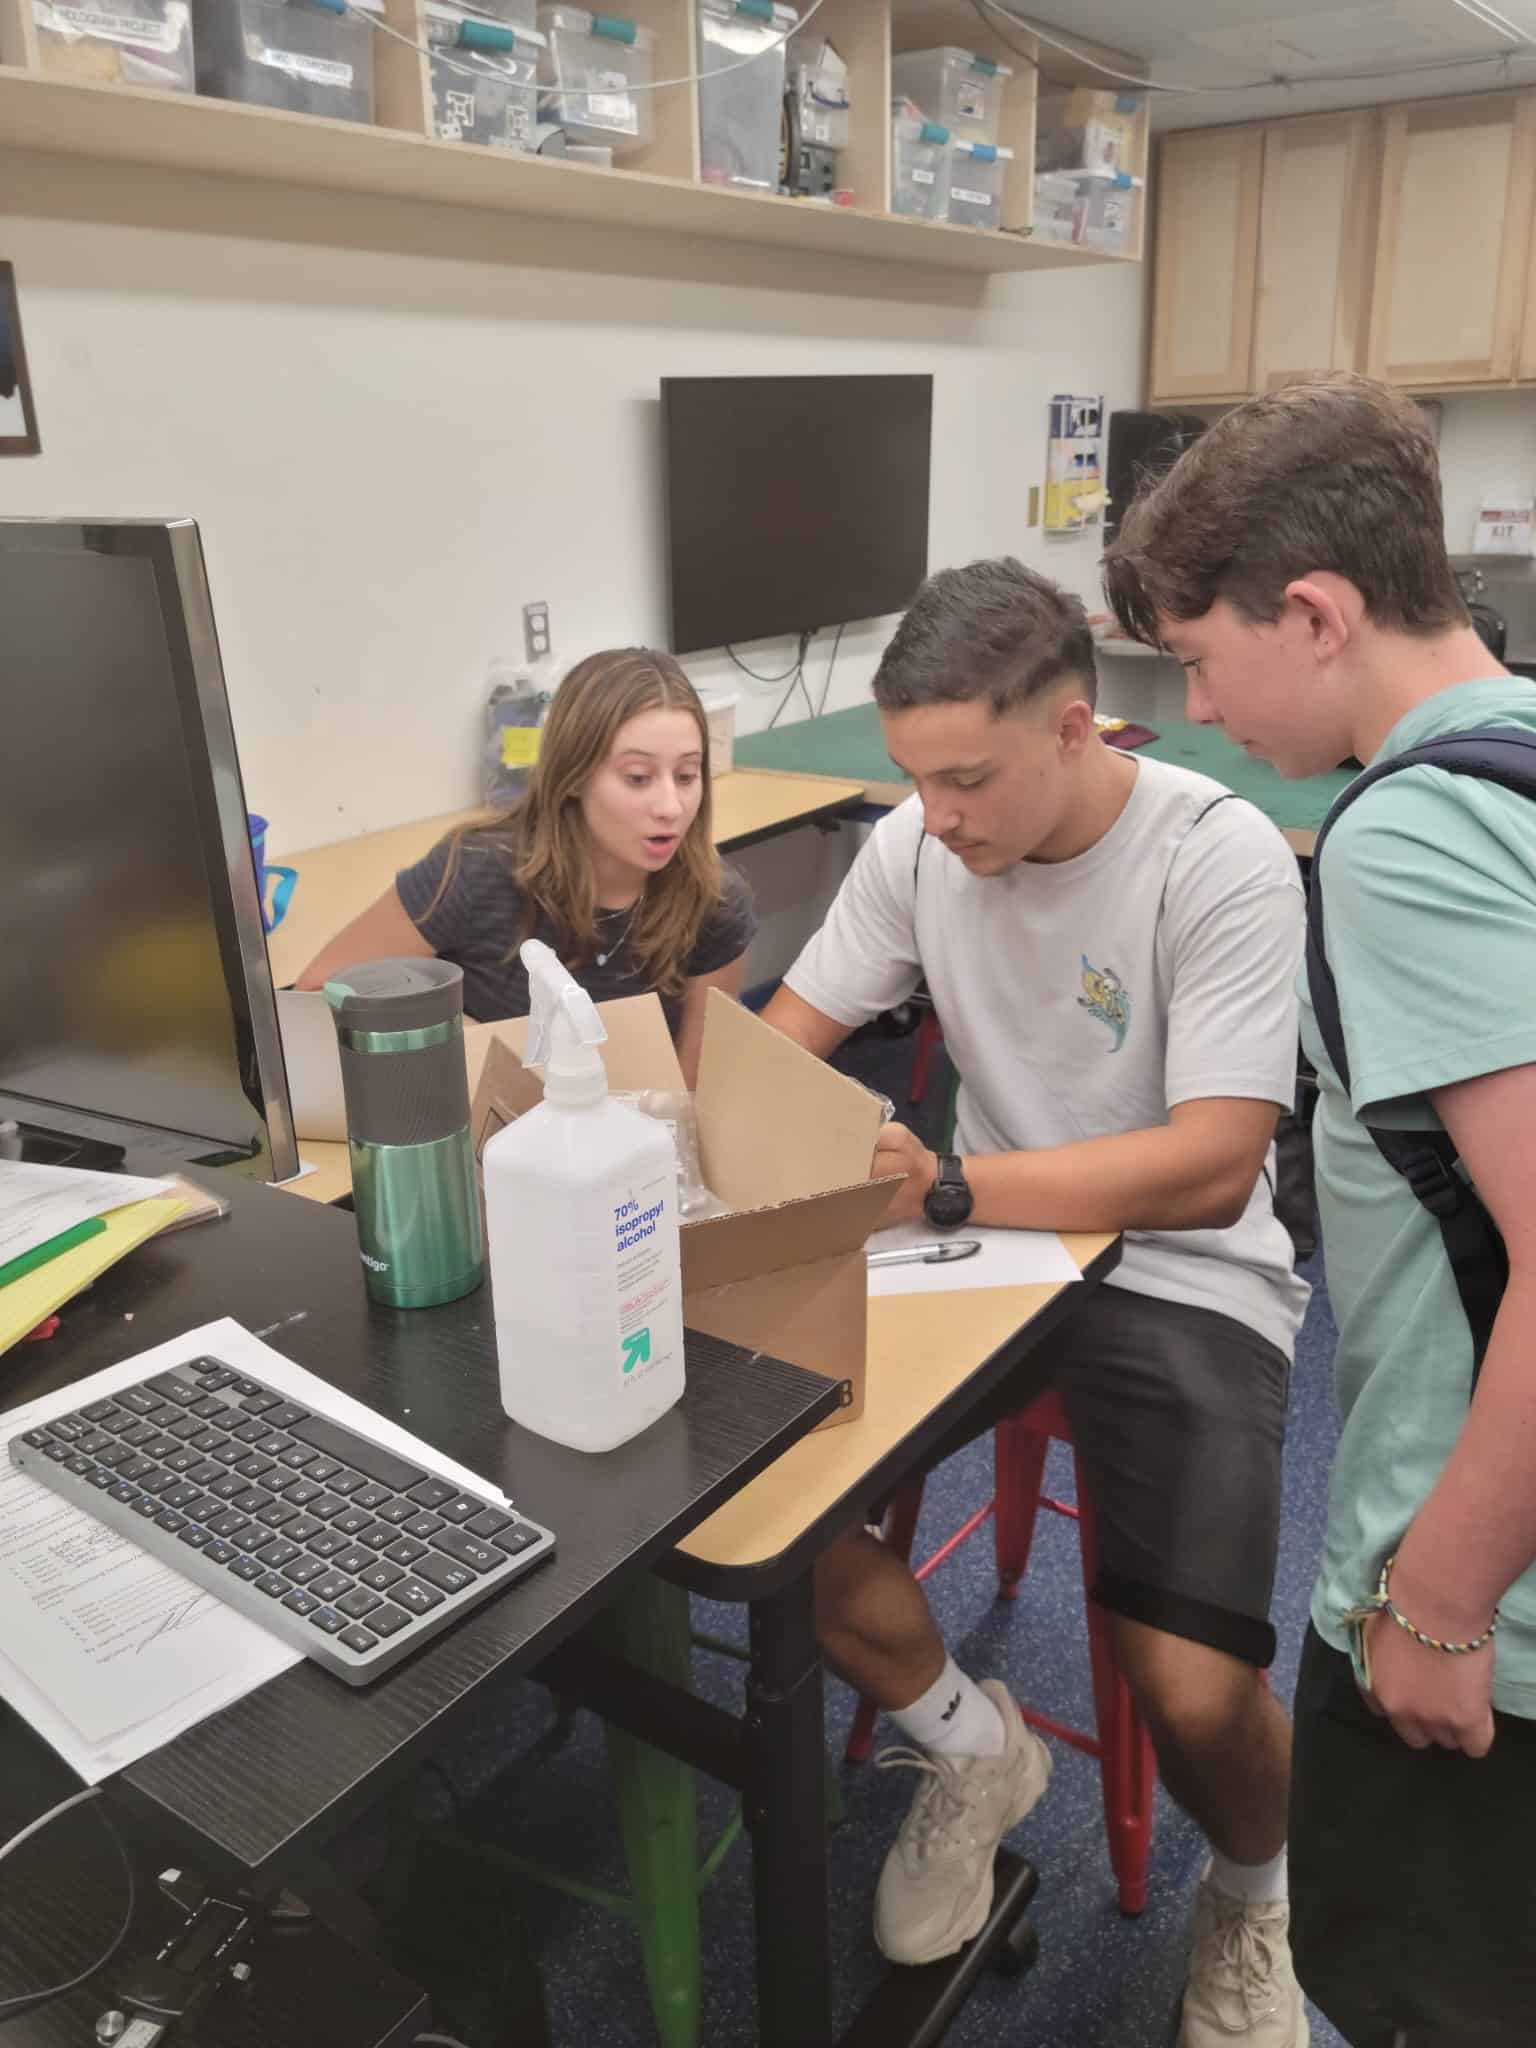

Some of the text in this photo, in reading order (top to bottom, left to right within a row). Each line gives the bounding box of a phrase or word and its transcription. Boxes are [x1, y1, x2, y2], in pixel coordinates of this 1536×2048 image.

[614, 1200, 639, 1221] 70%
[616, 1200, 664, 1237] isopropyl
[617, 1220, 656, 1252] alcohol
